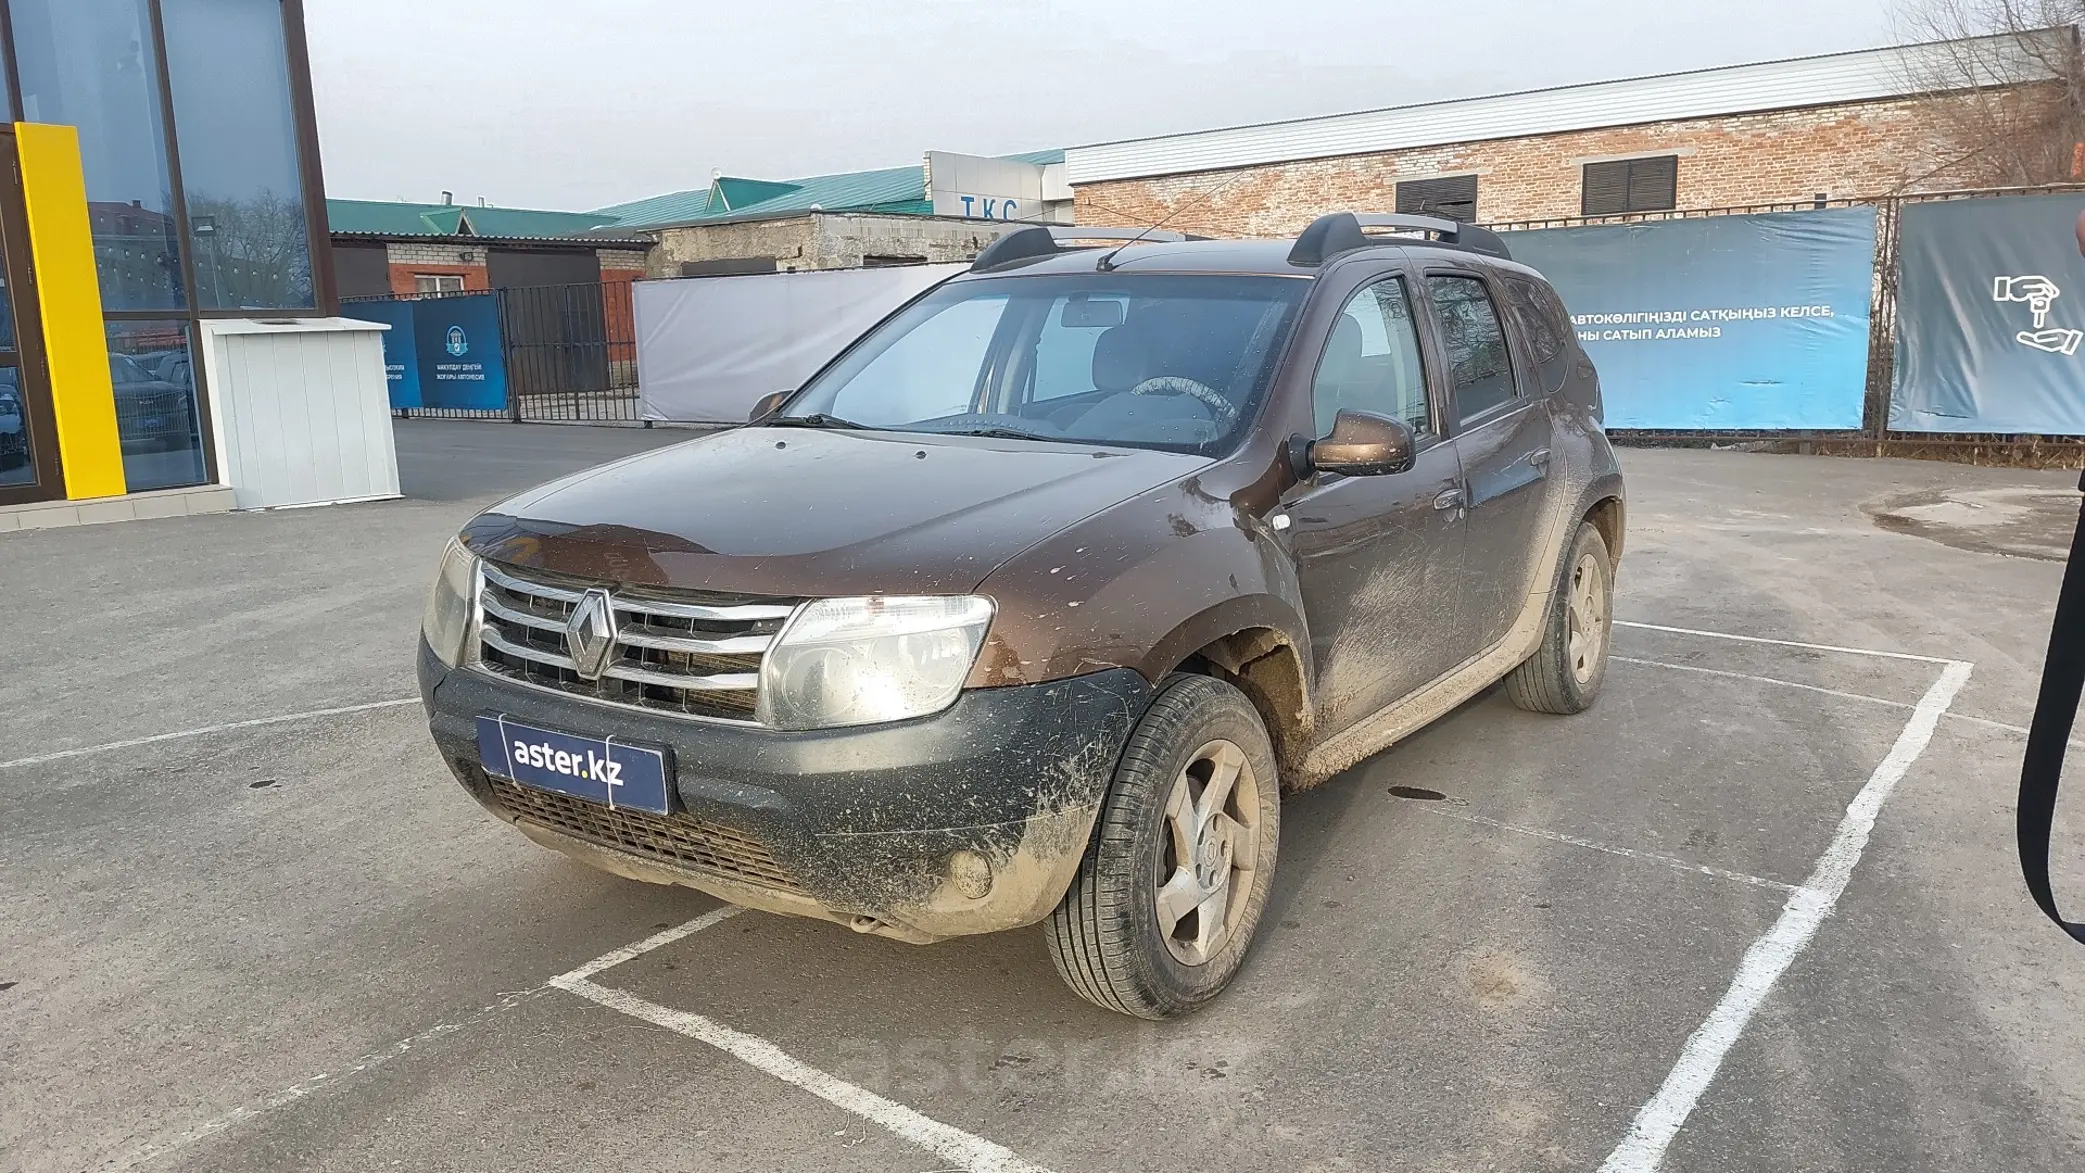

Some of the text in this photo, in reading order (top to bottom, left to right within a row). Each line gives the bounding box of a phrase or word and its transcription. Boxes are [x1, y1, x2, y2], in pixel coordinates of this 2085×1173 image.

[1690, 308, 1777, 323] САТҚЫҢЫЗ
[1779, 305, 1835, 319] КЕЛСЕ,
[1577, 326, 1721, 342] НЫ САТЫП АЛАМЫЗ
[514, 741, 624, 786] aster.kz
